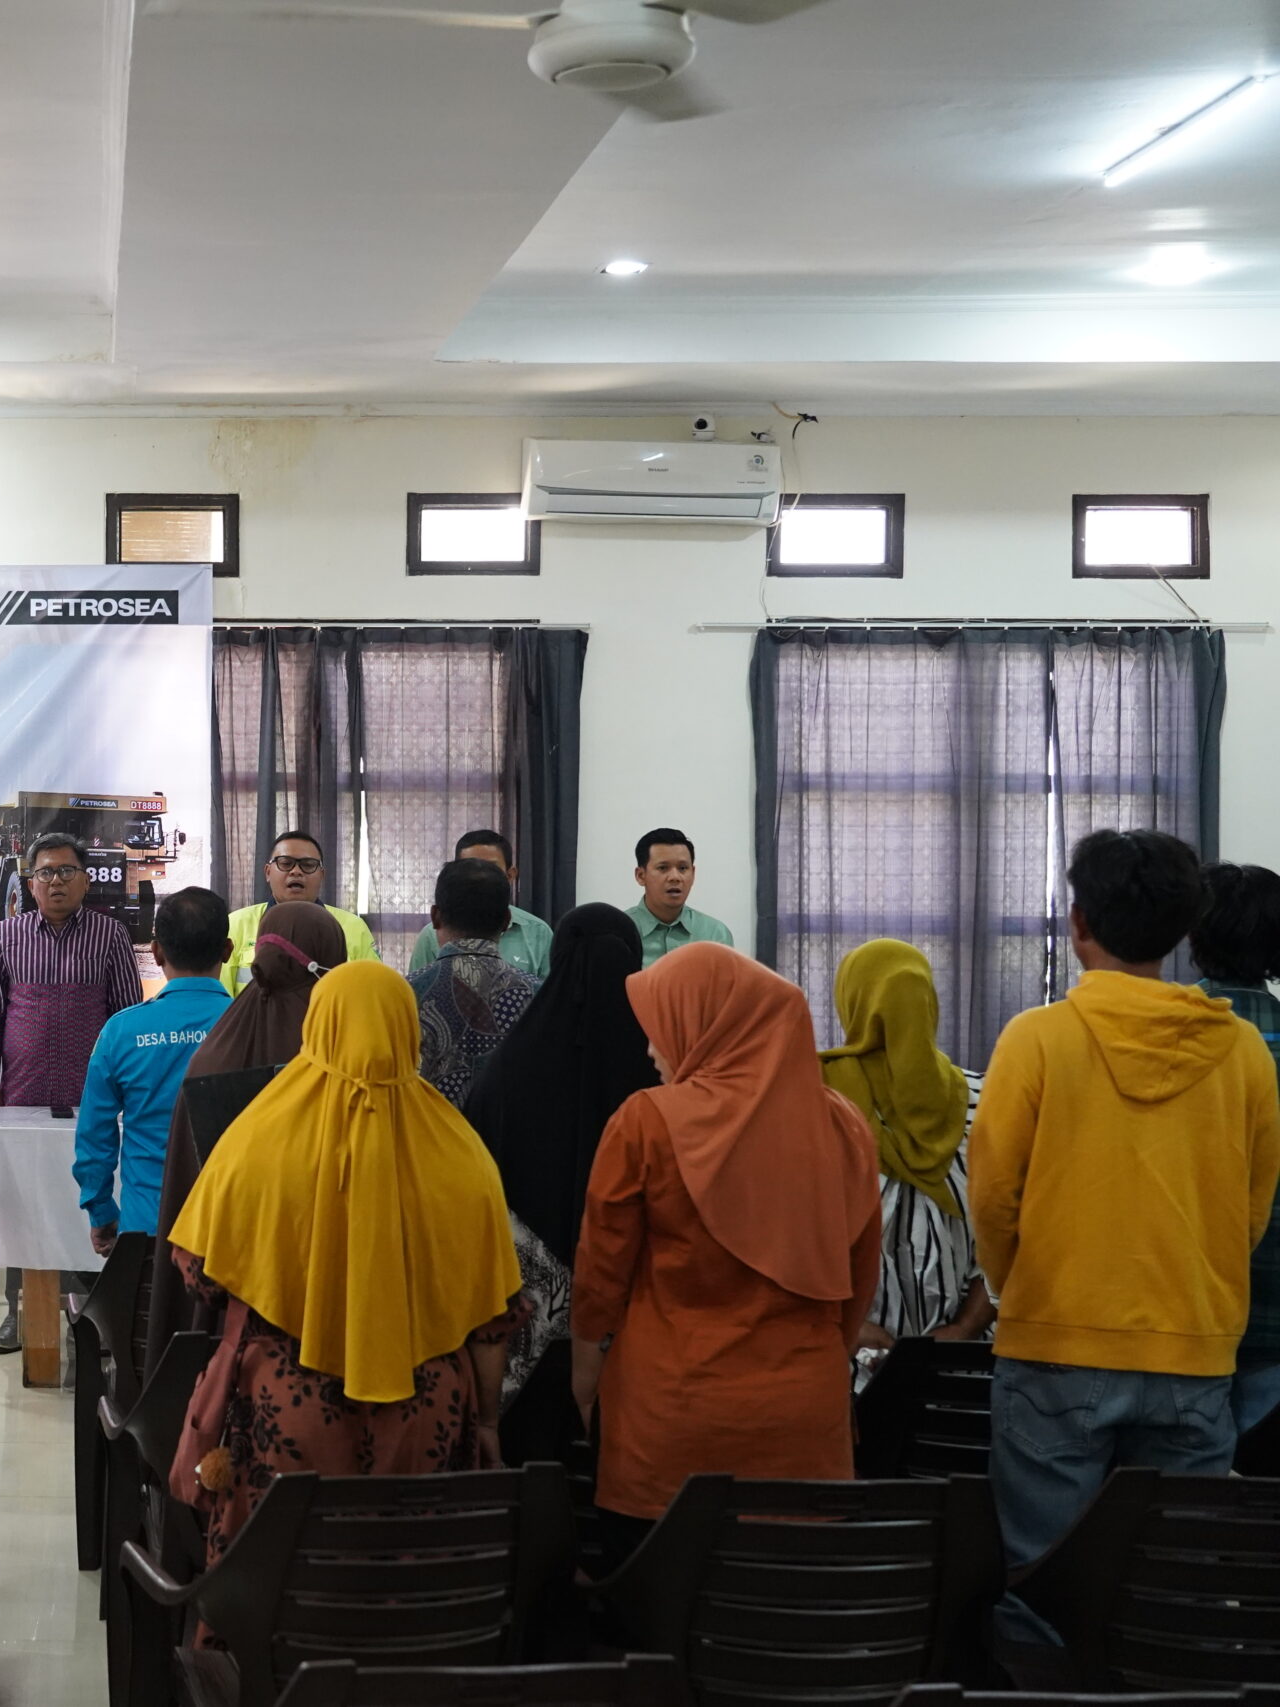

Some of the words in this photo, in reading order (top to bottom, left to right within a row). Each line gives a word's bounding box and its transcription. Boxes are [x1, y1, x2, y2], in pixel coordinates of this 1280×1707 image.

[29, 597, 172, 618] PETROSEA
[130, 801, 162, 810] DT8888
[136, 1032, 166, 1047] DESA
